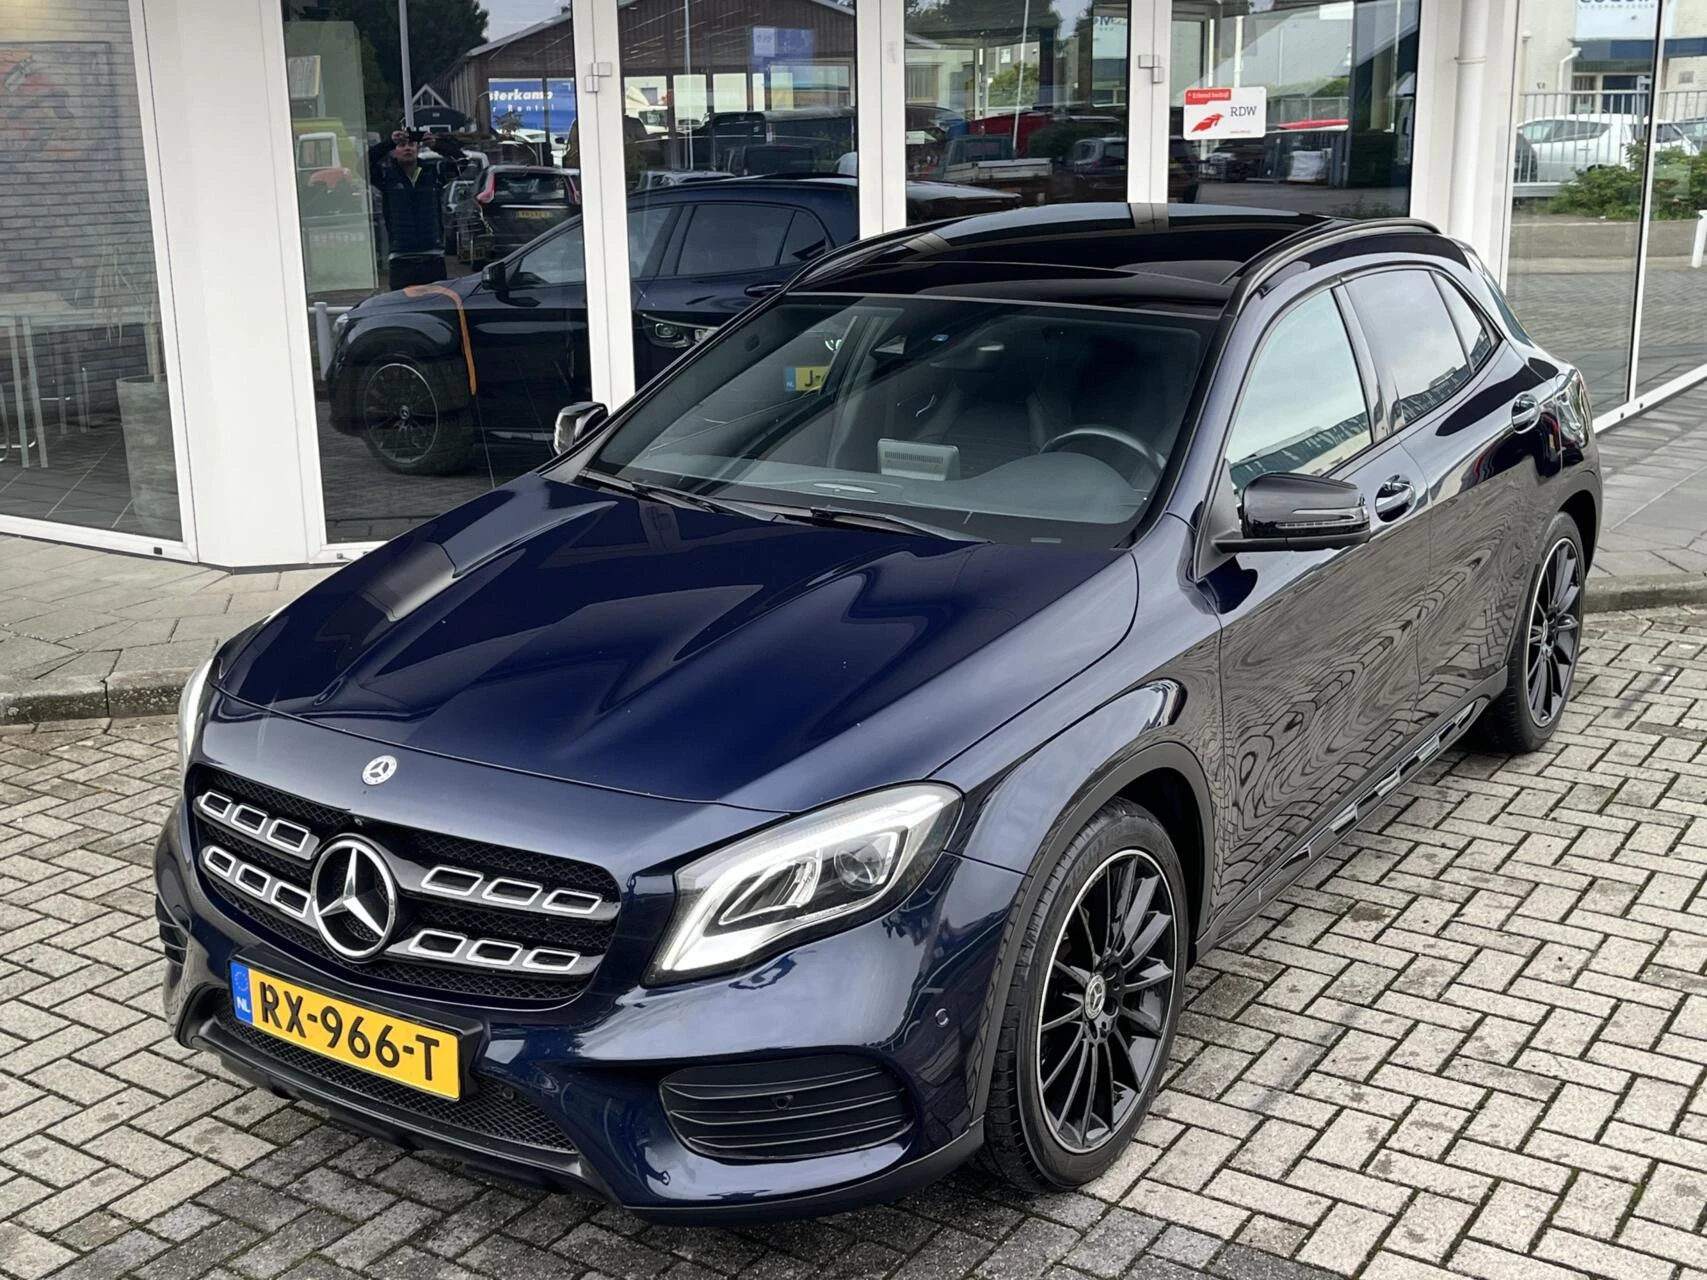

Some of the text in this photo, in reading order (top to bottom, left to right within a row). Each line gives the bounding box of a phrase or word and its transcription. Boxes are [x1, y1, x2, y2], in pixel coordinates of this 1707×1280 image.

[1230, 106, 1257, 117] RDW
[236, 996, 251, 1013] NL
[259, 981, 440, 1081] RX-966-T
